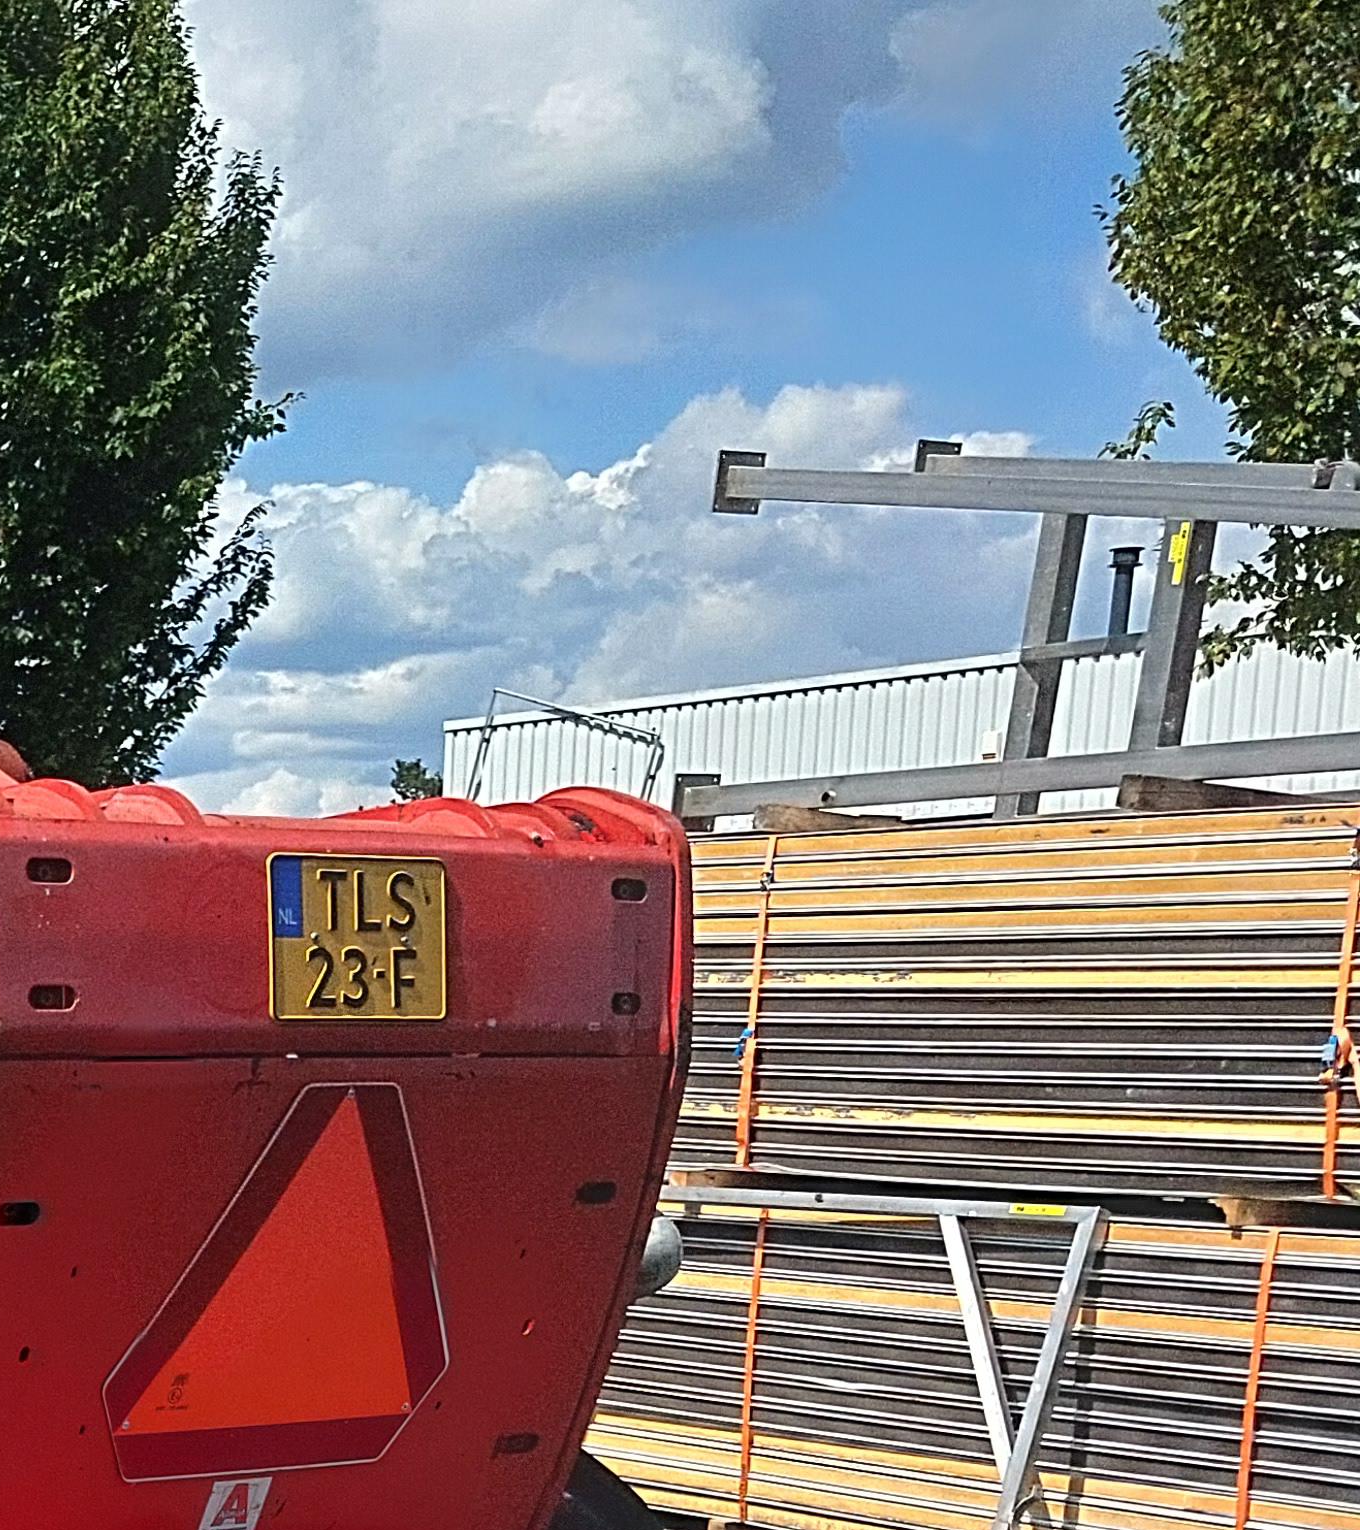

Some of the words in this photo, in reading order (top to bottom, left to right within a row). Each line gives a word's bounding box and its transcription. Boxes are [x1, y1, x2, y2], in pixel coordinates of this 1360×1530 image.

[277, 907, 298, 926] NL
[316, 870, 416, 933] TLS
[305, 945, 418, 1009] 23-F
